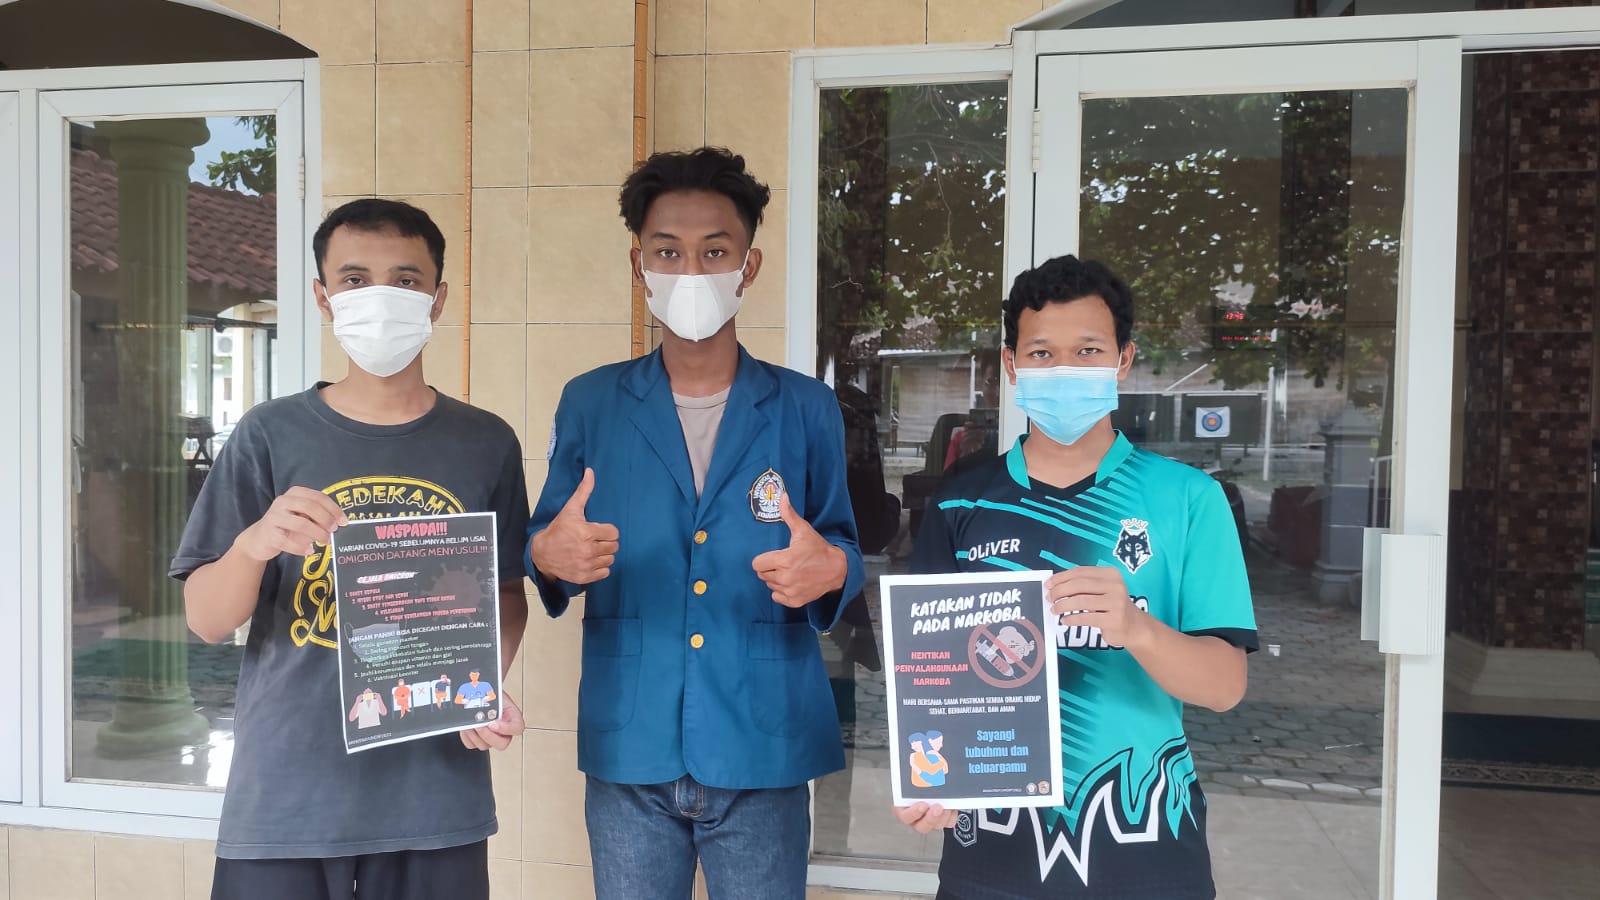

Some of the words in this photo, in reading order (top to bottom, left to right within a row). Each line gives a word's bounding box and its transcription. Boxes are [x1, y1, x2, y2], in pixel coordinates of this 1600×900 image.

[336, 485, 446, 516] EDEKAH
[375, 522, 448, 539] WASPADA!!!
[339, 544, 364, 553] VARIAN
[365, 541, 398, 550] COVID-19
[399, 538, 444, 547] SEBELUMNYA
[337, 554, 385, 565] OMICRON
[386, 550, 426, 560] DATANG
[428, 546, 488, 556] MENYUSUL!!!
[910, 595, 975, 618] KATAKAN
[979, 588, 1022, 607] TIDAK
[912, 616, 950, 635] PADA
[954, 606, 1026, 629] NARKOBA.
[911, 651, 950, 660] HENTIKAN
[913, 678, 951, 686] NARKOBA
[977, 728, 1015, 743] Sayangi
[965, 746, 1008, 758] tubuhmu
[1010, 745, 1029, 757] dan
[968, 761, 1027, 775] keluargamu
